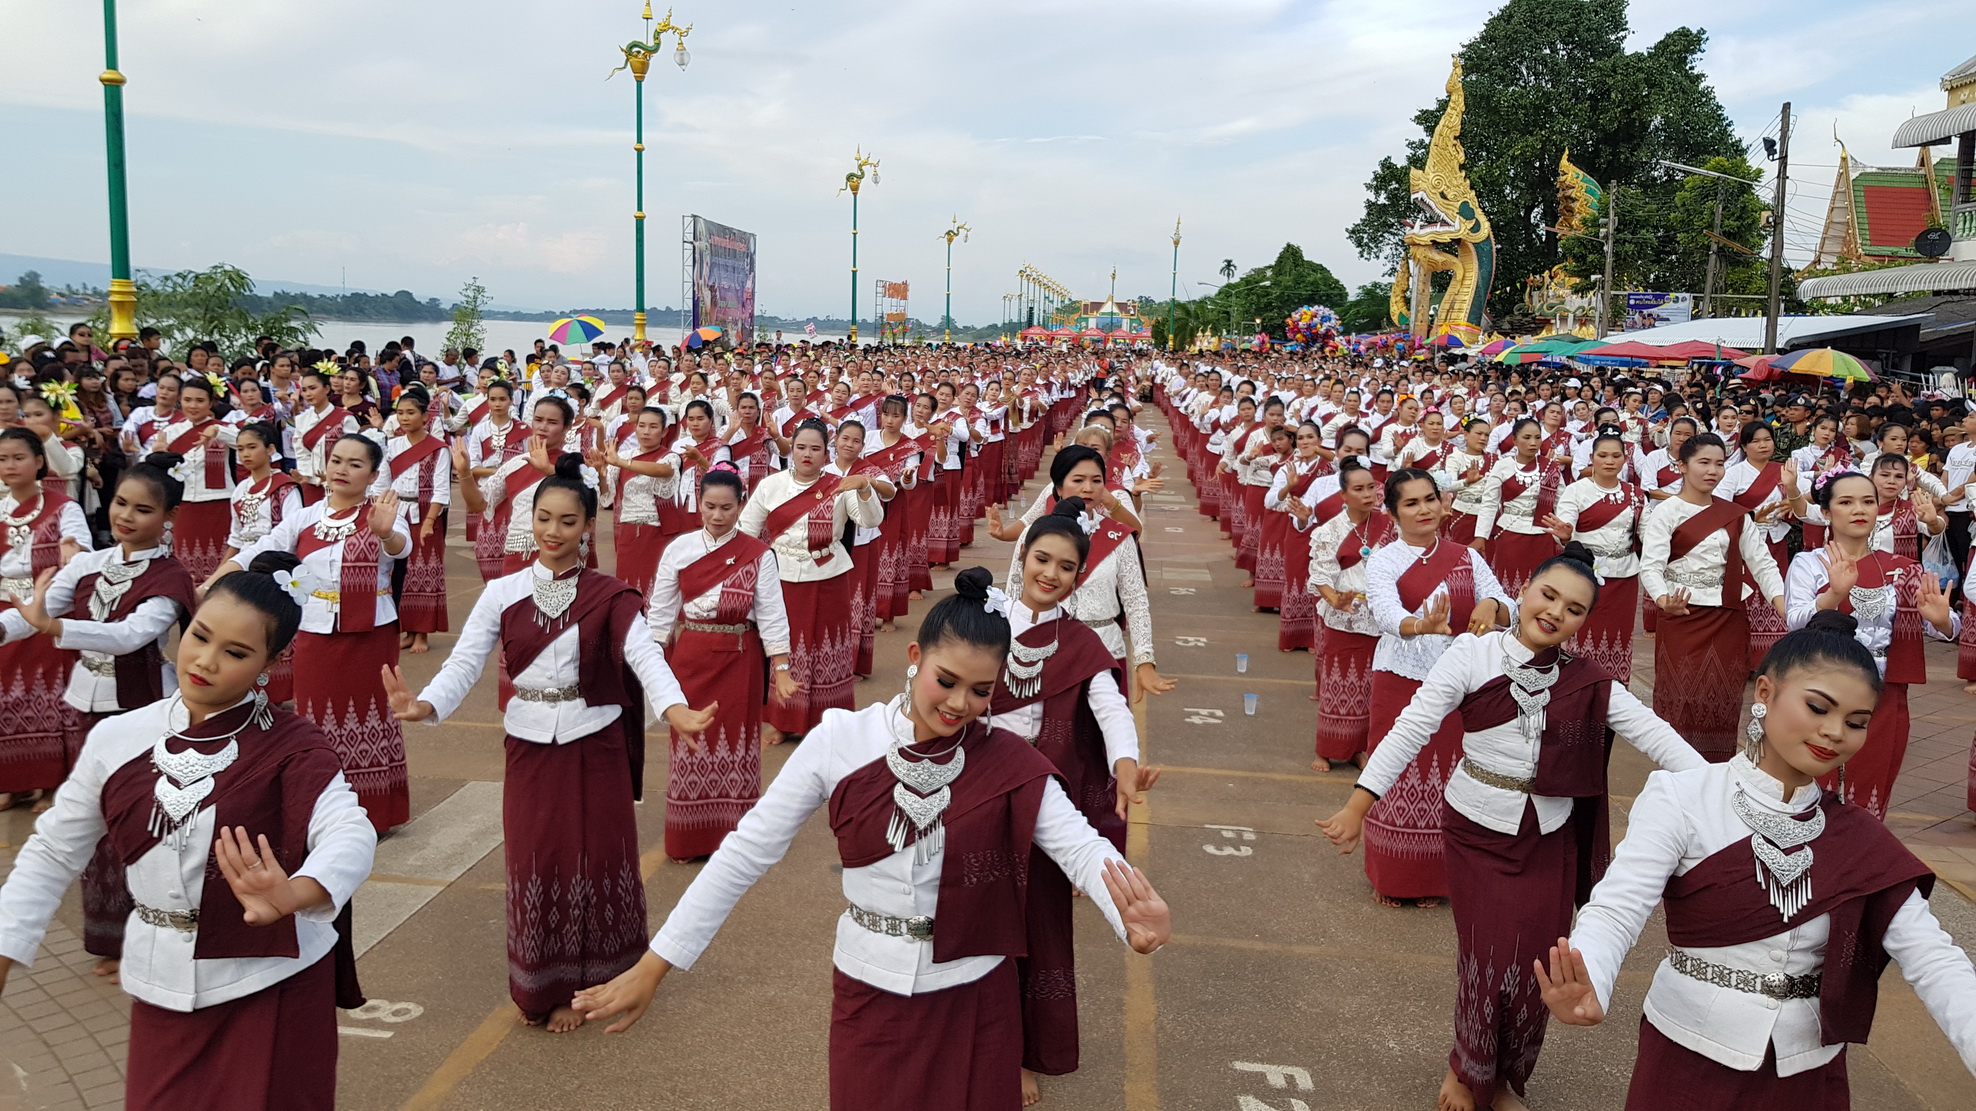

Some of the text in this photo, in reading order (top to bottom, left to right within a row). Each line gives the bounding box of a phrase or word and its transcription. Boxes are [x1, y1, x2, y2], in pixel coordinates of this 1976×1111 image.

[1175, 636, 1207, 647] F5
[1183, 708, 1225, 725] F4
[1203, 824, 1257, 857] F3
